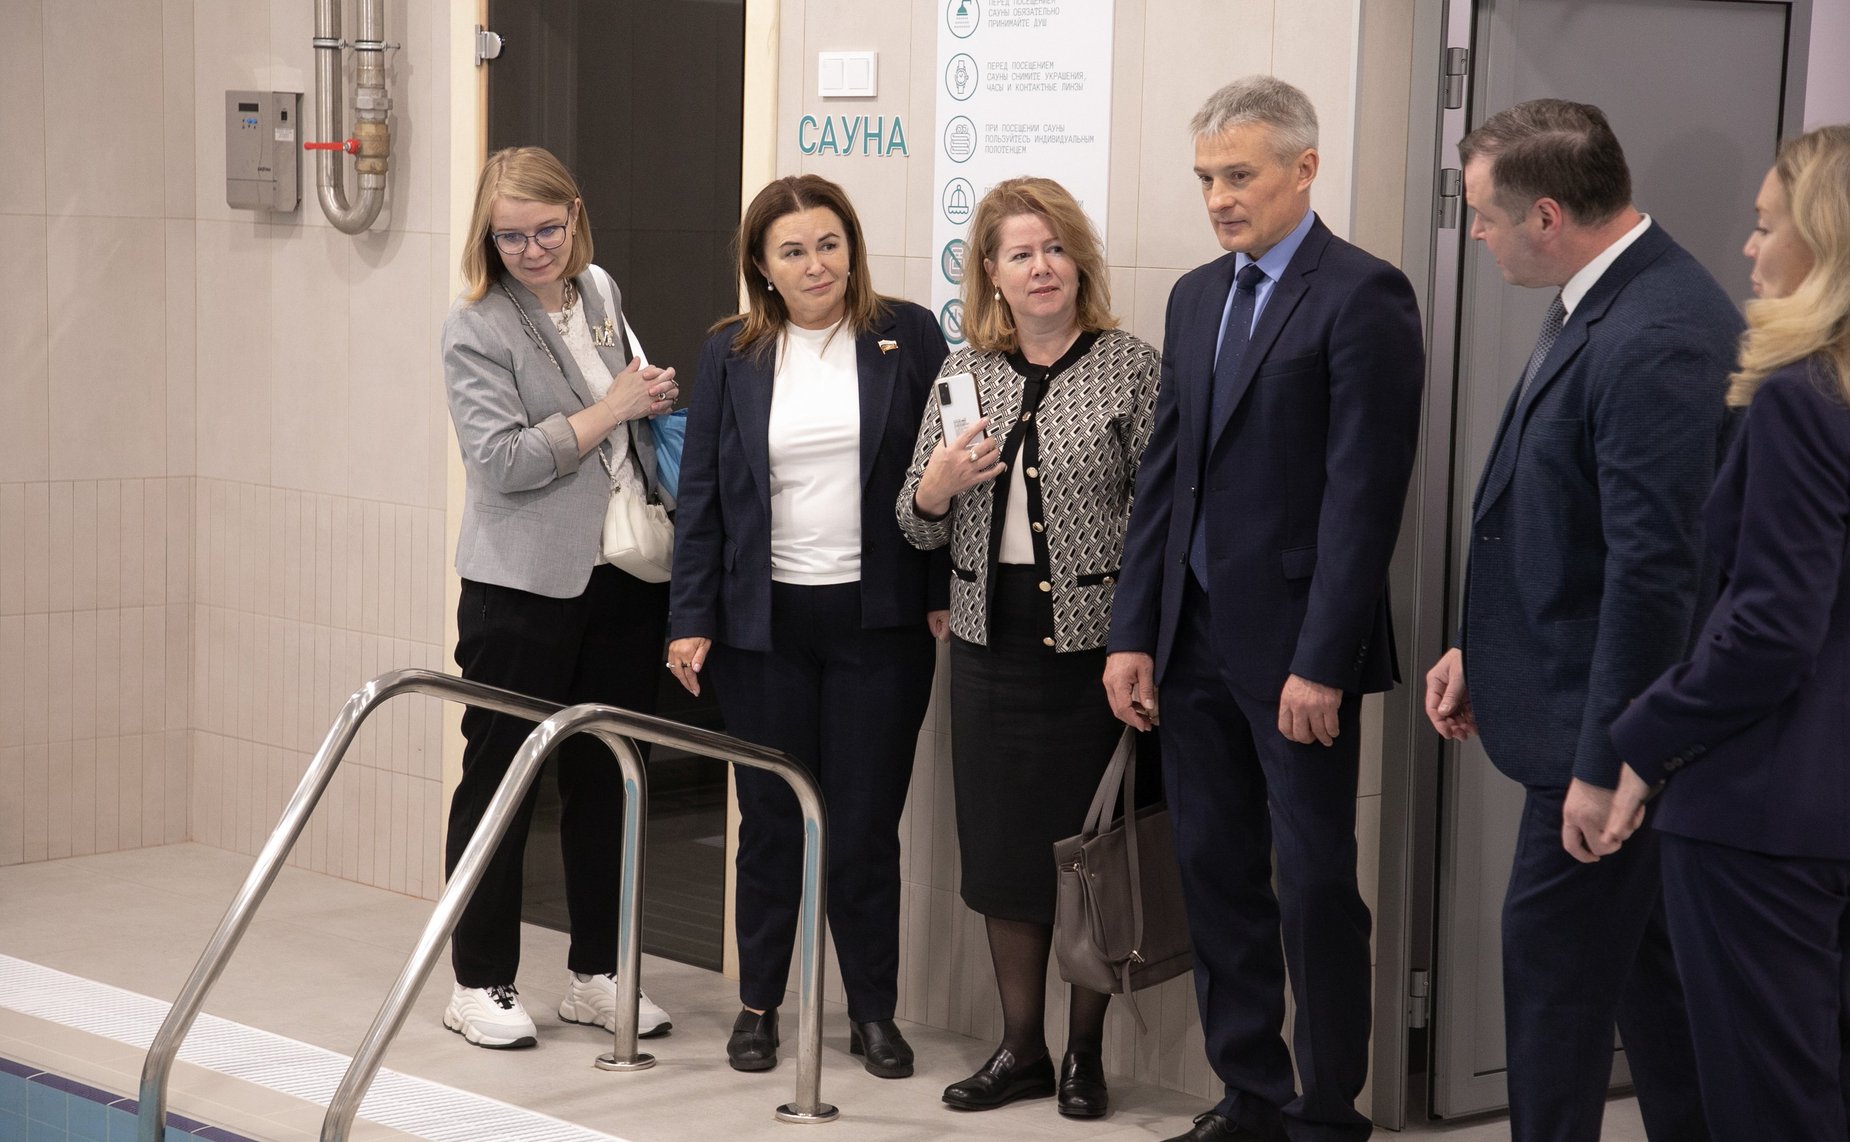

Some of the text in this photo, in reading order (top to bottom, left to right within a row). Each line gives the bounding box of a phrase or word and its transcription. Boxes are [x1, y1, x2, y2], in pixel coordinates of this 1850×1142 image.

[988, 7, 1060, 17] САУНЫ ОБЯЗАТЕЛЬНО
[988, 17, 1047, 27] ПРИНИМАЙТЕ ДУШ
[987, 61, 1054, 71] ПЕРЕД ПОСЕЩЕНИЕМ
[987, 71, 1087, 82] САУНЫ СНИМИТЕ УКРАШЕНИЯ,
[987, 82, 1084, 92] ЧАСЫ И КОНТАКТНЫЕ ЛИНЗЫ
[985, 123, 1065, 132] ПРИ ПОСЕЩЕНИИ САУНЫ
[799, 114, 909, 157] САУНА
[985, 134, 1095, 144] ПОЛЬЗУЙТЕСЬ ИНДИВИДУАЛЬНЫМ
[984, 145, 1027, 154] ПОЛОТЕНЦЕМ
